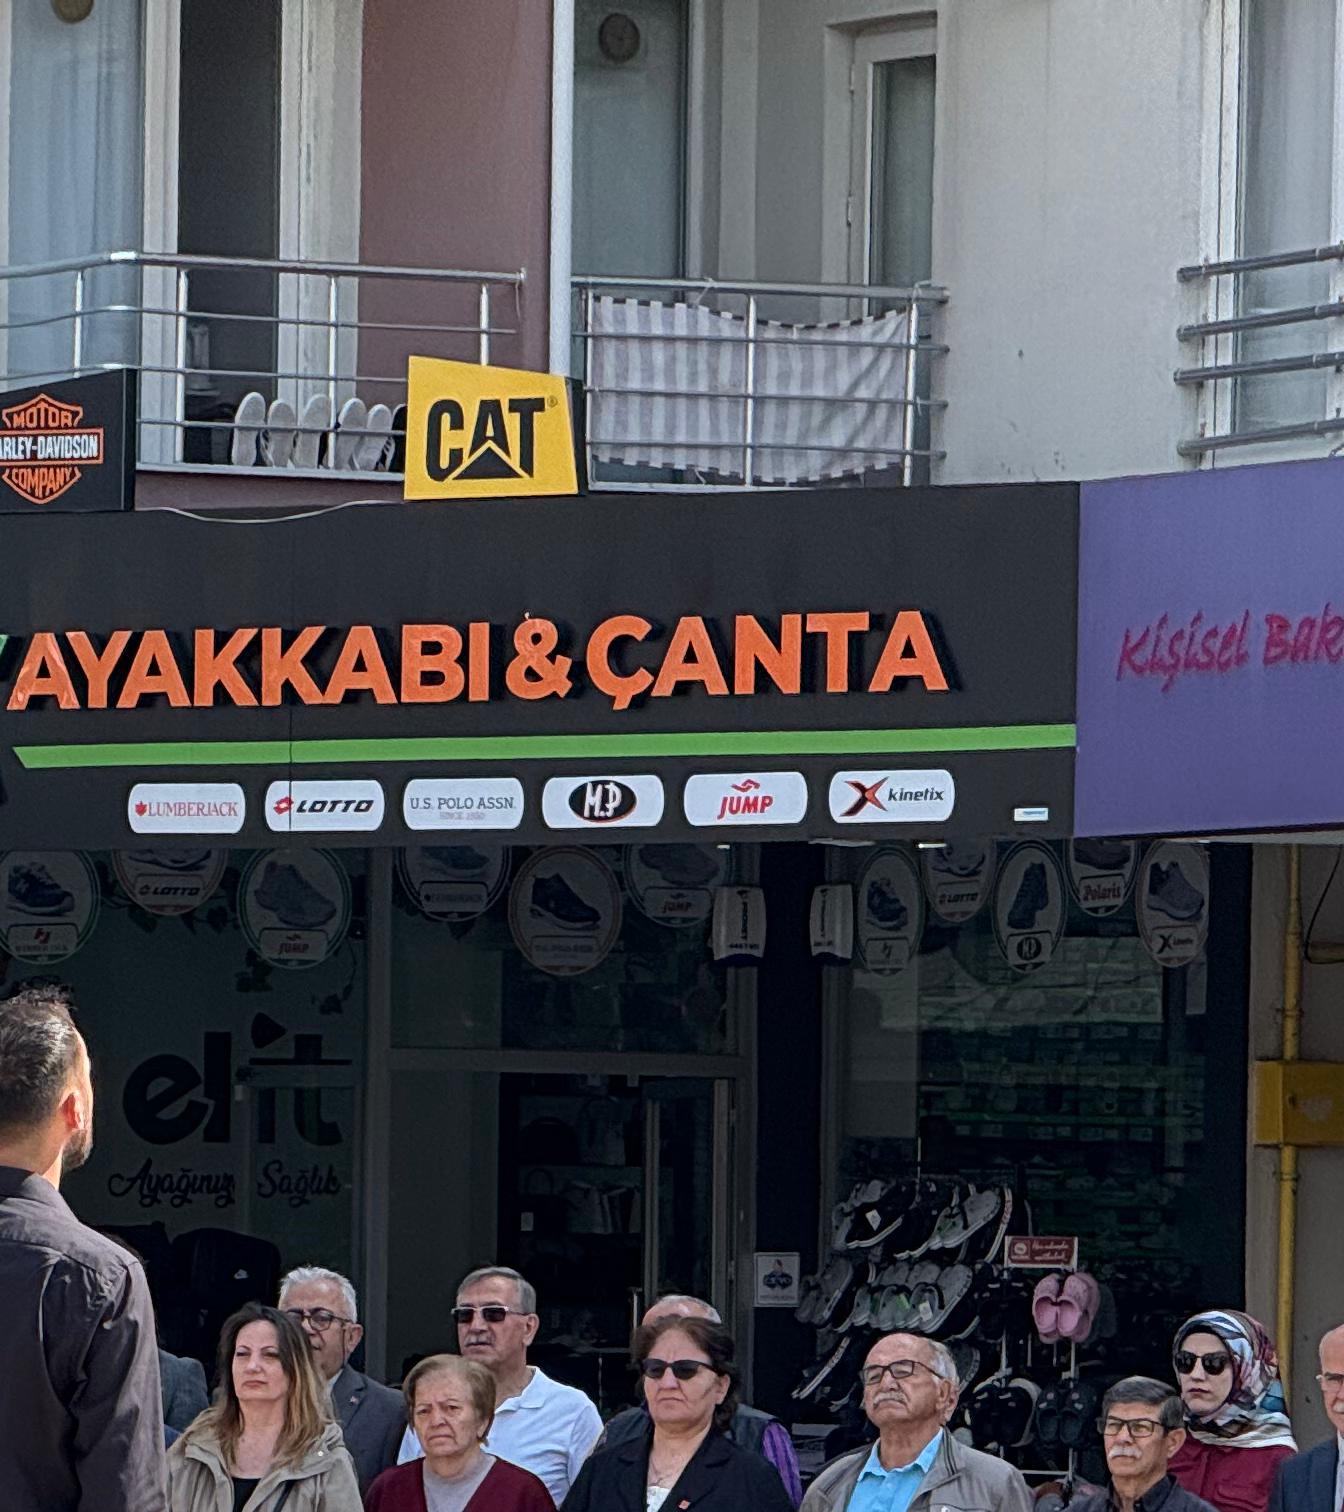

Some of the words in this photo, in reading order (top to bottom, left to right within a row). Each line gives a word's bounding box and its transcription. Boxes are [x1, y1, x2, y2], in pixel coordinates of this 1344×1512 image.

[12, 402, 73, 428] MOTOR
[425, 397, 545, 482] CAT
[12, 466, 73, 498] COMPANY
[296, 799, 374, 814] LOTTO
[437, 797, 474, 810] POLO
[887, 786, 945, 803] kinetix
[148, 801, 239, 817] LUMBERJACK
[717, 795, 774, 820] JUMP
[122, 1012, 353, 1146] elit
